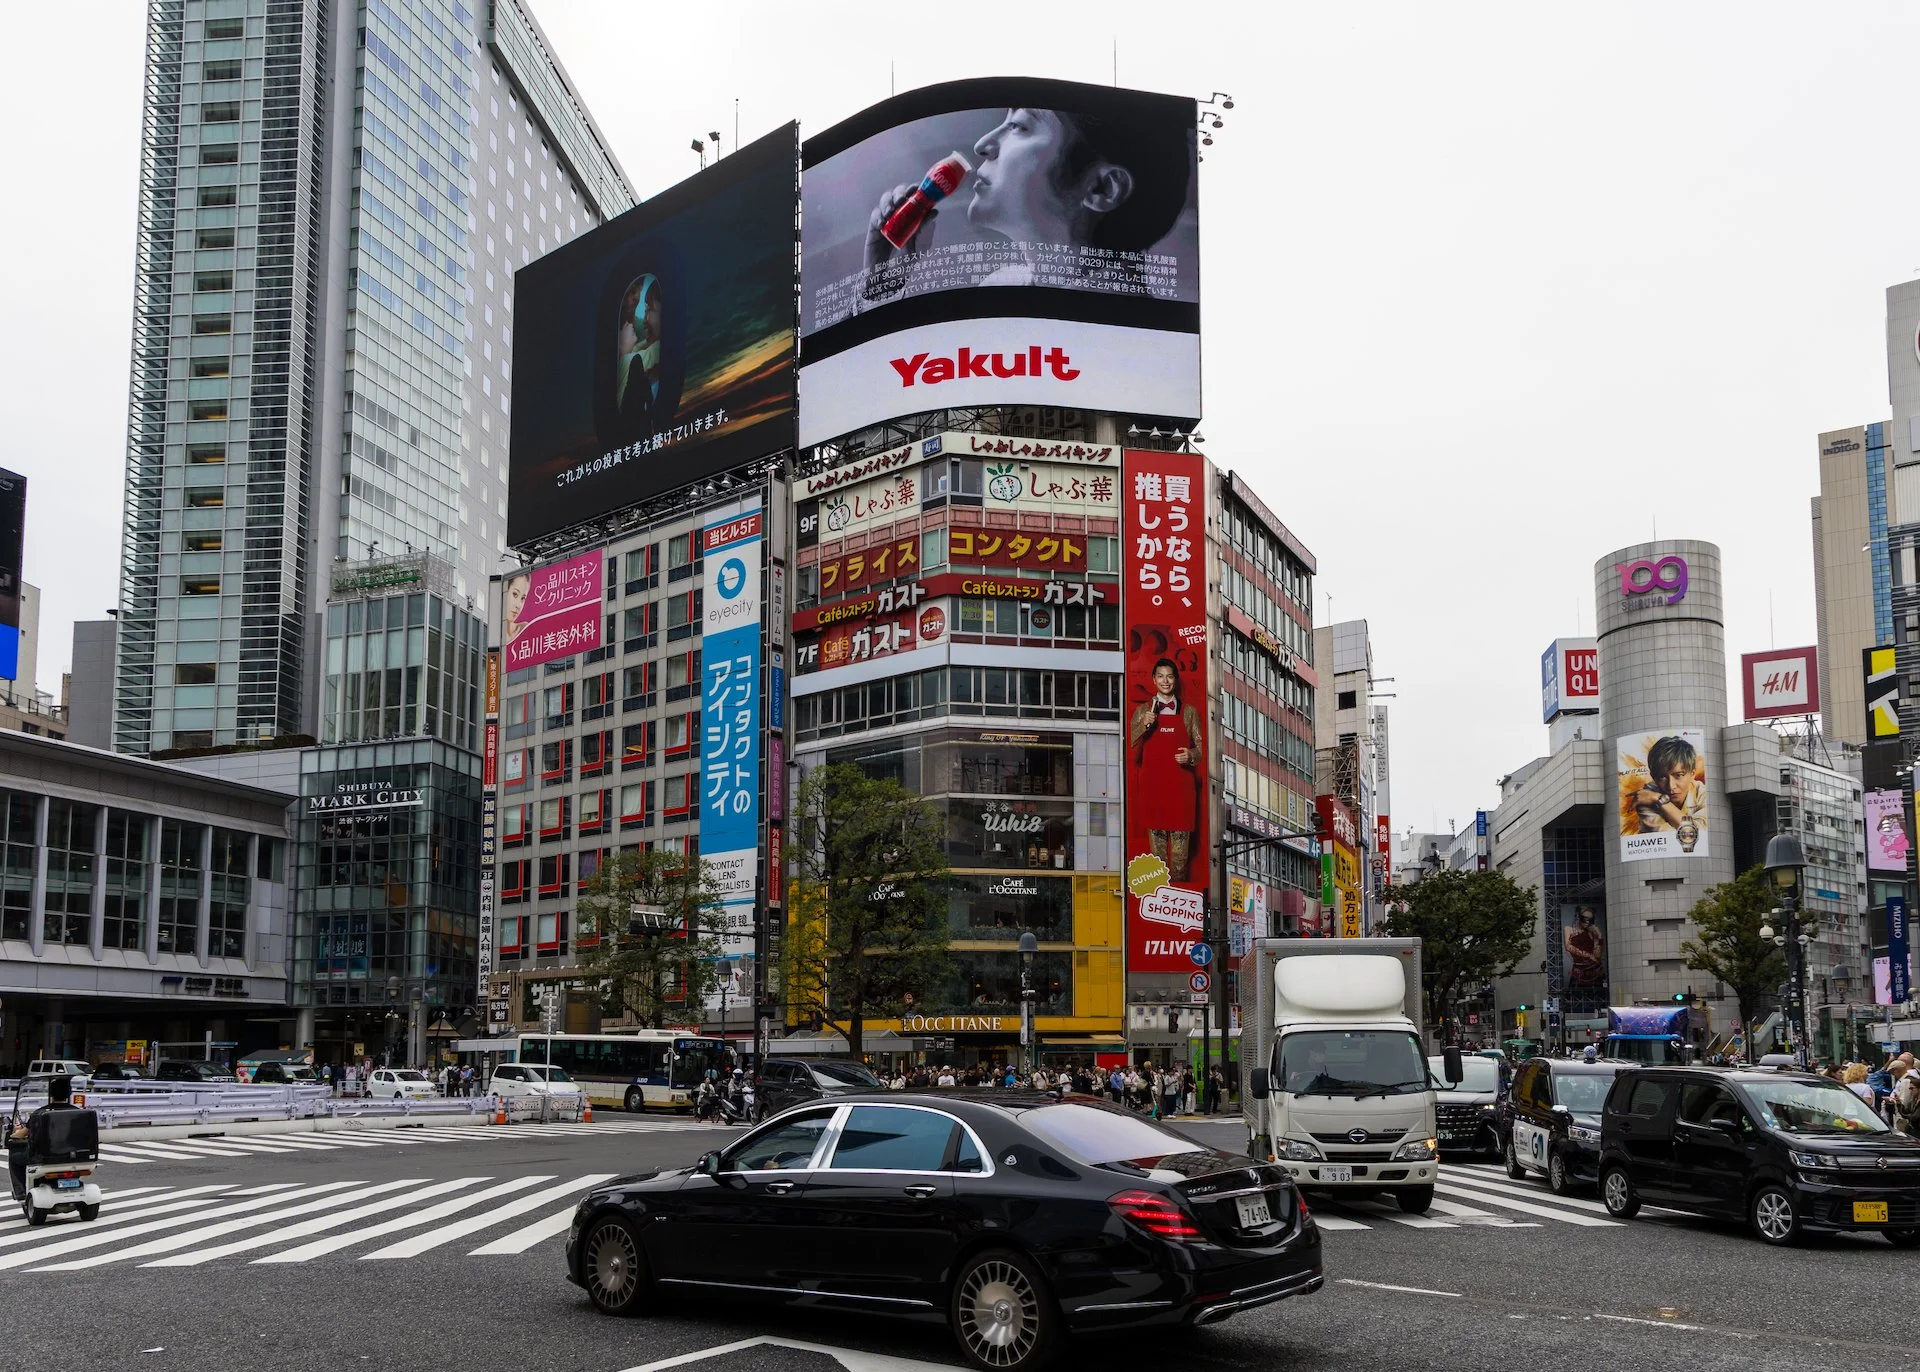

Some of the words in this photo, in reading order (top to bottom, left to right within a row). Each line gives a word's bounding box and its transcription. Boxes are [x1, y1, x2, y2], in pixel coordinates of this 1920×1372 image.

[1062, 255, 1076, 265] YIT
[889, 346, 1081, 387] Yakult
[557, 408, 729, 487] これからの投資を考え続けていきます。
[971, 436, 1113, 462] しゃぶしゃぶバイキング
[1823, 443, 1860, 455] INDIGO
[807, 446, 913, 494] しゃぶしゃぶバイキング
[855, 479, 915, 518] しゃぶ葉
[1031, 472, 1113, 503] しゃぶ葉
[709, 517, 756, 546] 当ビル5F
[800, 514, 818, 533] 9F
[951, 532, 1082, 563] コンタクト
[1134, 471, 1163, 607] 推しから。
[1164, 475, 1193, 608] 買うなら、
[547, 562, 598, 590] 品川スキン
[822, 540, 917, 589] プライス
[1615, 555, 1688, 605] 109
[547, 580, 592, 607] クリニック
[817, 600, 875, 624] Caféレストラン
[877, 583, 926, 615] ガスト
[962, 580, 1039, 598] Caféレストラン
[1044, 581, 1104, 606] ガスト
[709, 599, 754, 624] eyecity
[922, 620, 944, 633] ガスト
[518, 620, 597, 661] 品川美容外科
[823, 637, 849, 655] Café
[851, 622, 911, 662] ガスト
[797, 644, 819, 665] 7F
[1762, 670, 1799, 695] H&M
[733, 655, 752, 814] コンタクトの
[1377, 714, 1385, 732] BIC
[707, 659, 732, 817] アイシティ
[1377, 736, 1386, 782] CAMERA
[310, 793, 367, 809] MARK
[377, 789, 424, 803] CITY
[338, 781, 392, 793] SHIBUYA
[355, 815, 389, 824] マークシティ
[771, 809, 780, 818] 4F
[981, 812, 1042, 832] Ushi8
[1311, 841, 1320, 857] 4F
[1627, 837, 1667, 848] HUAWEI
[711, 859, 744, 871] CONTACT
[718, 871, 736, 880] LENS
[1131, 867, 1164, 886] CUTMAN
[705, 880, 750, 893] SPECIALISTS
[989, 884, 1037, 895] L'OCCITANE
[1002, 877, 1024, 888] CAFÉ
[1232, 881, 1243, 909] 薬
[482, 895, 491, 912] 内科
[1148, 903, 1204, 922] SHOPPING
[1161, 894, 1198, 909] ライブで
[1344, 891, 1356, 937] 処方せん
[481, 916, 491, 952] 産婦人科
[1893, 905, 1903, 939] MIZUHO
[1145, 940, 1196, 955] 17LIVE
[1245, 1206, 1269, 1224] 74-08
[1876, 1210, 1887, 1220] 15
